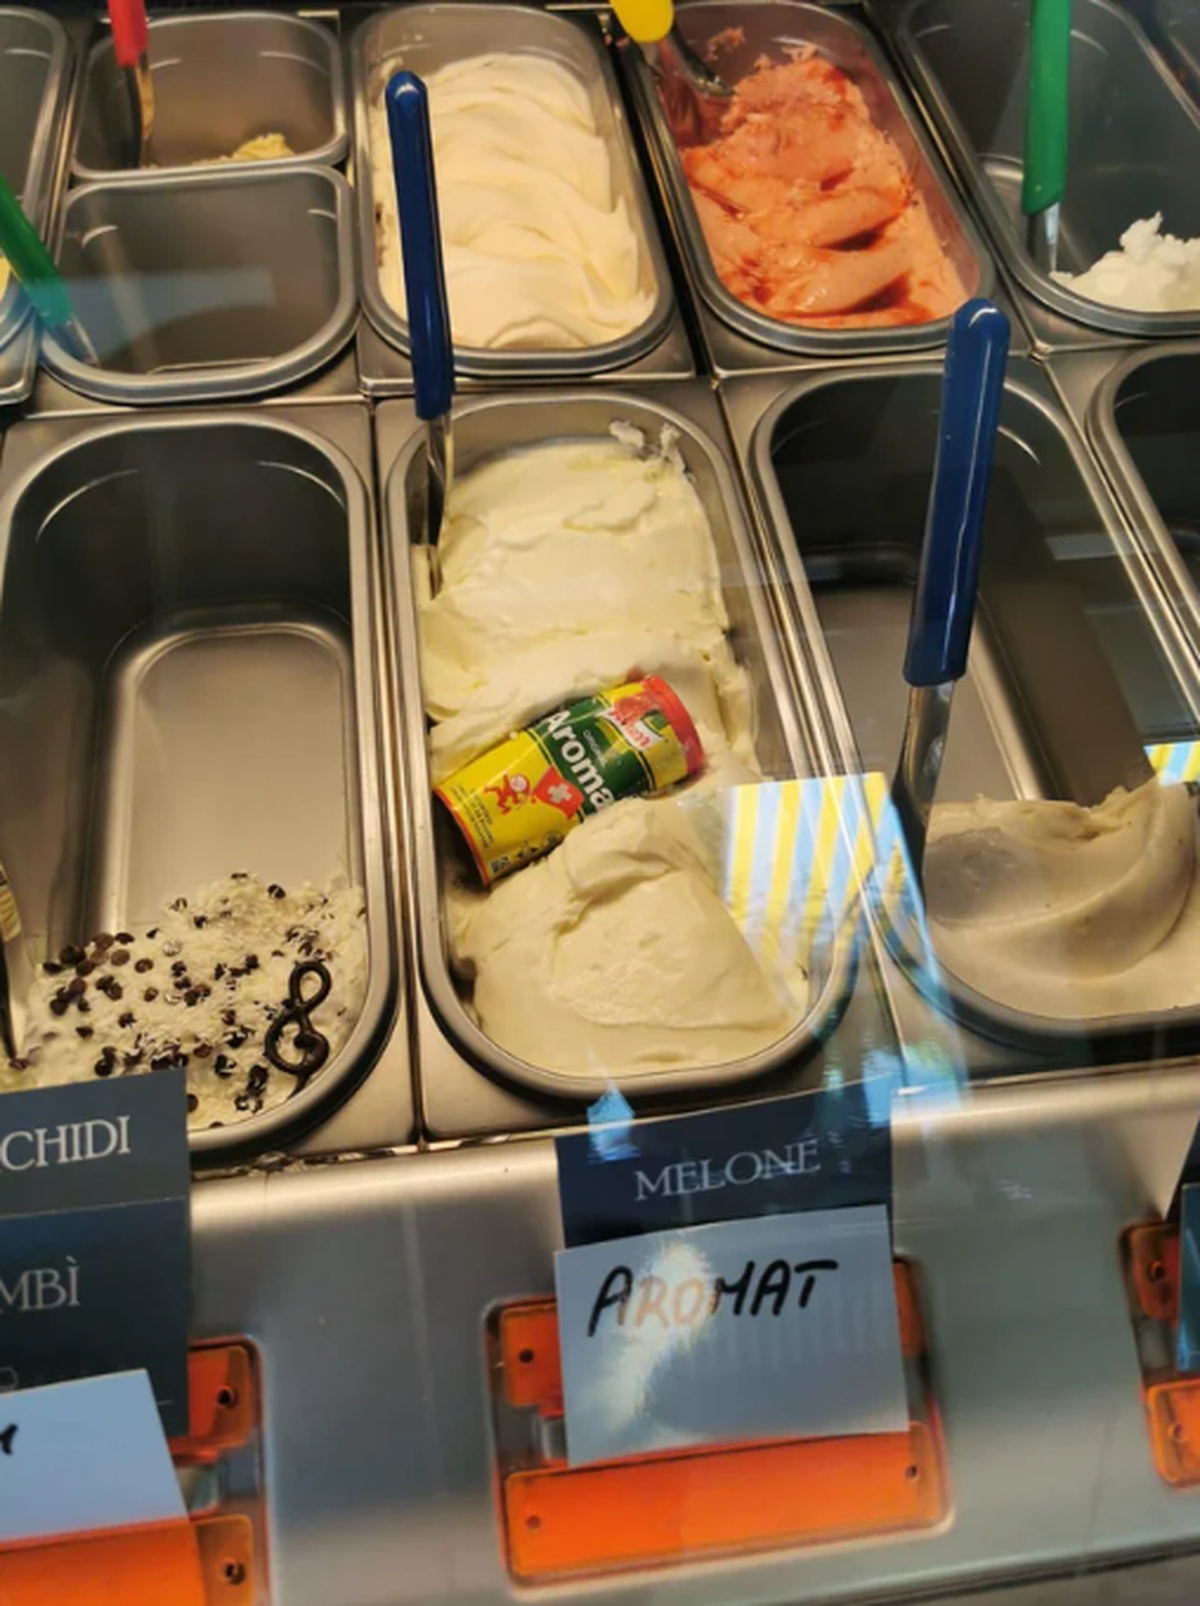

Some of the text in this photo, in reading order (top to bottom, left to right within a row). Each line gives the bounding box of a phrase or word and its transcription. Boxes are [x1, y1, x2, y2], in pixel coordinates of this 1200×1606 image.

[536, 710, 615, 812] Aroma
[0, 1115, 131, 1172] CHIDI
[634, 1139, 822, 1200] MELONE
[587, 1259, 839, 1338] AROMAT
